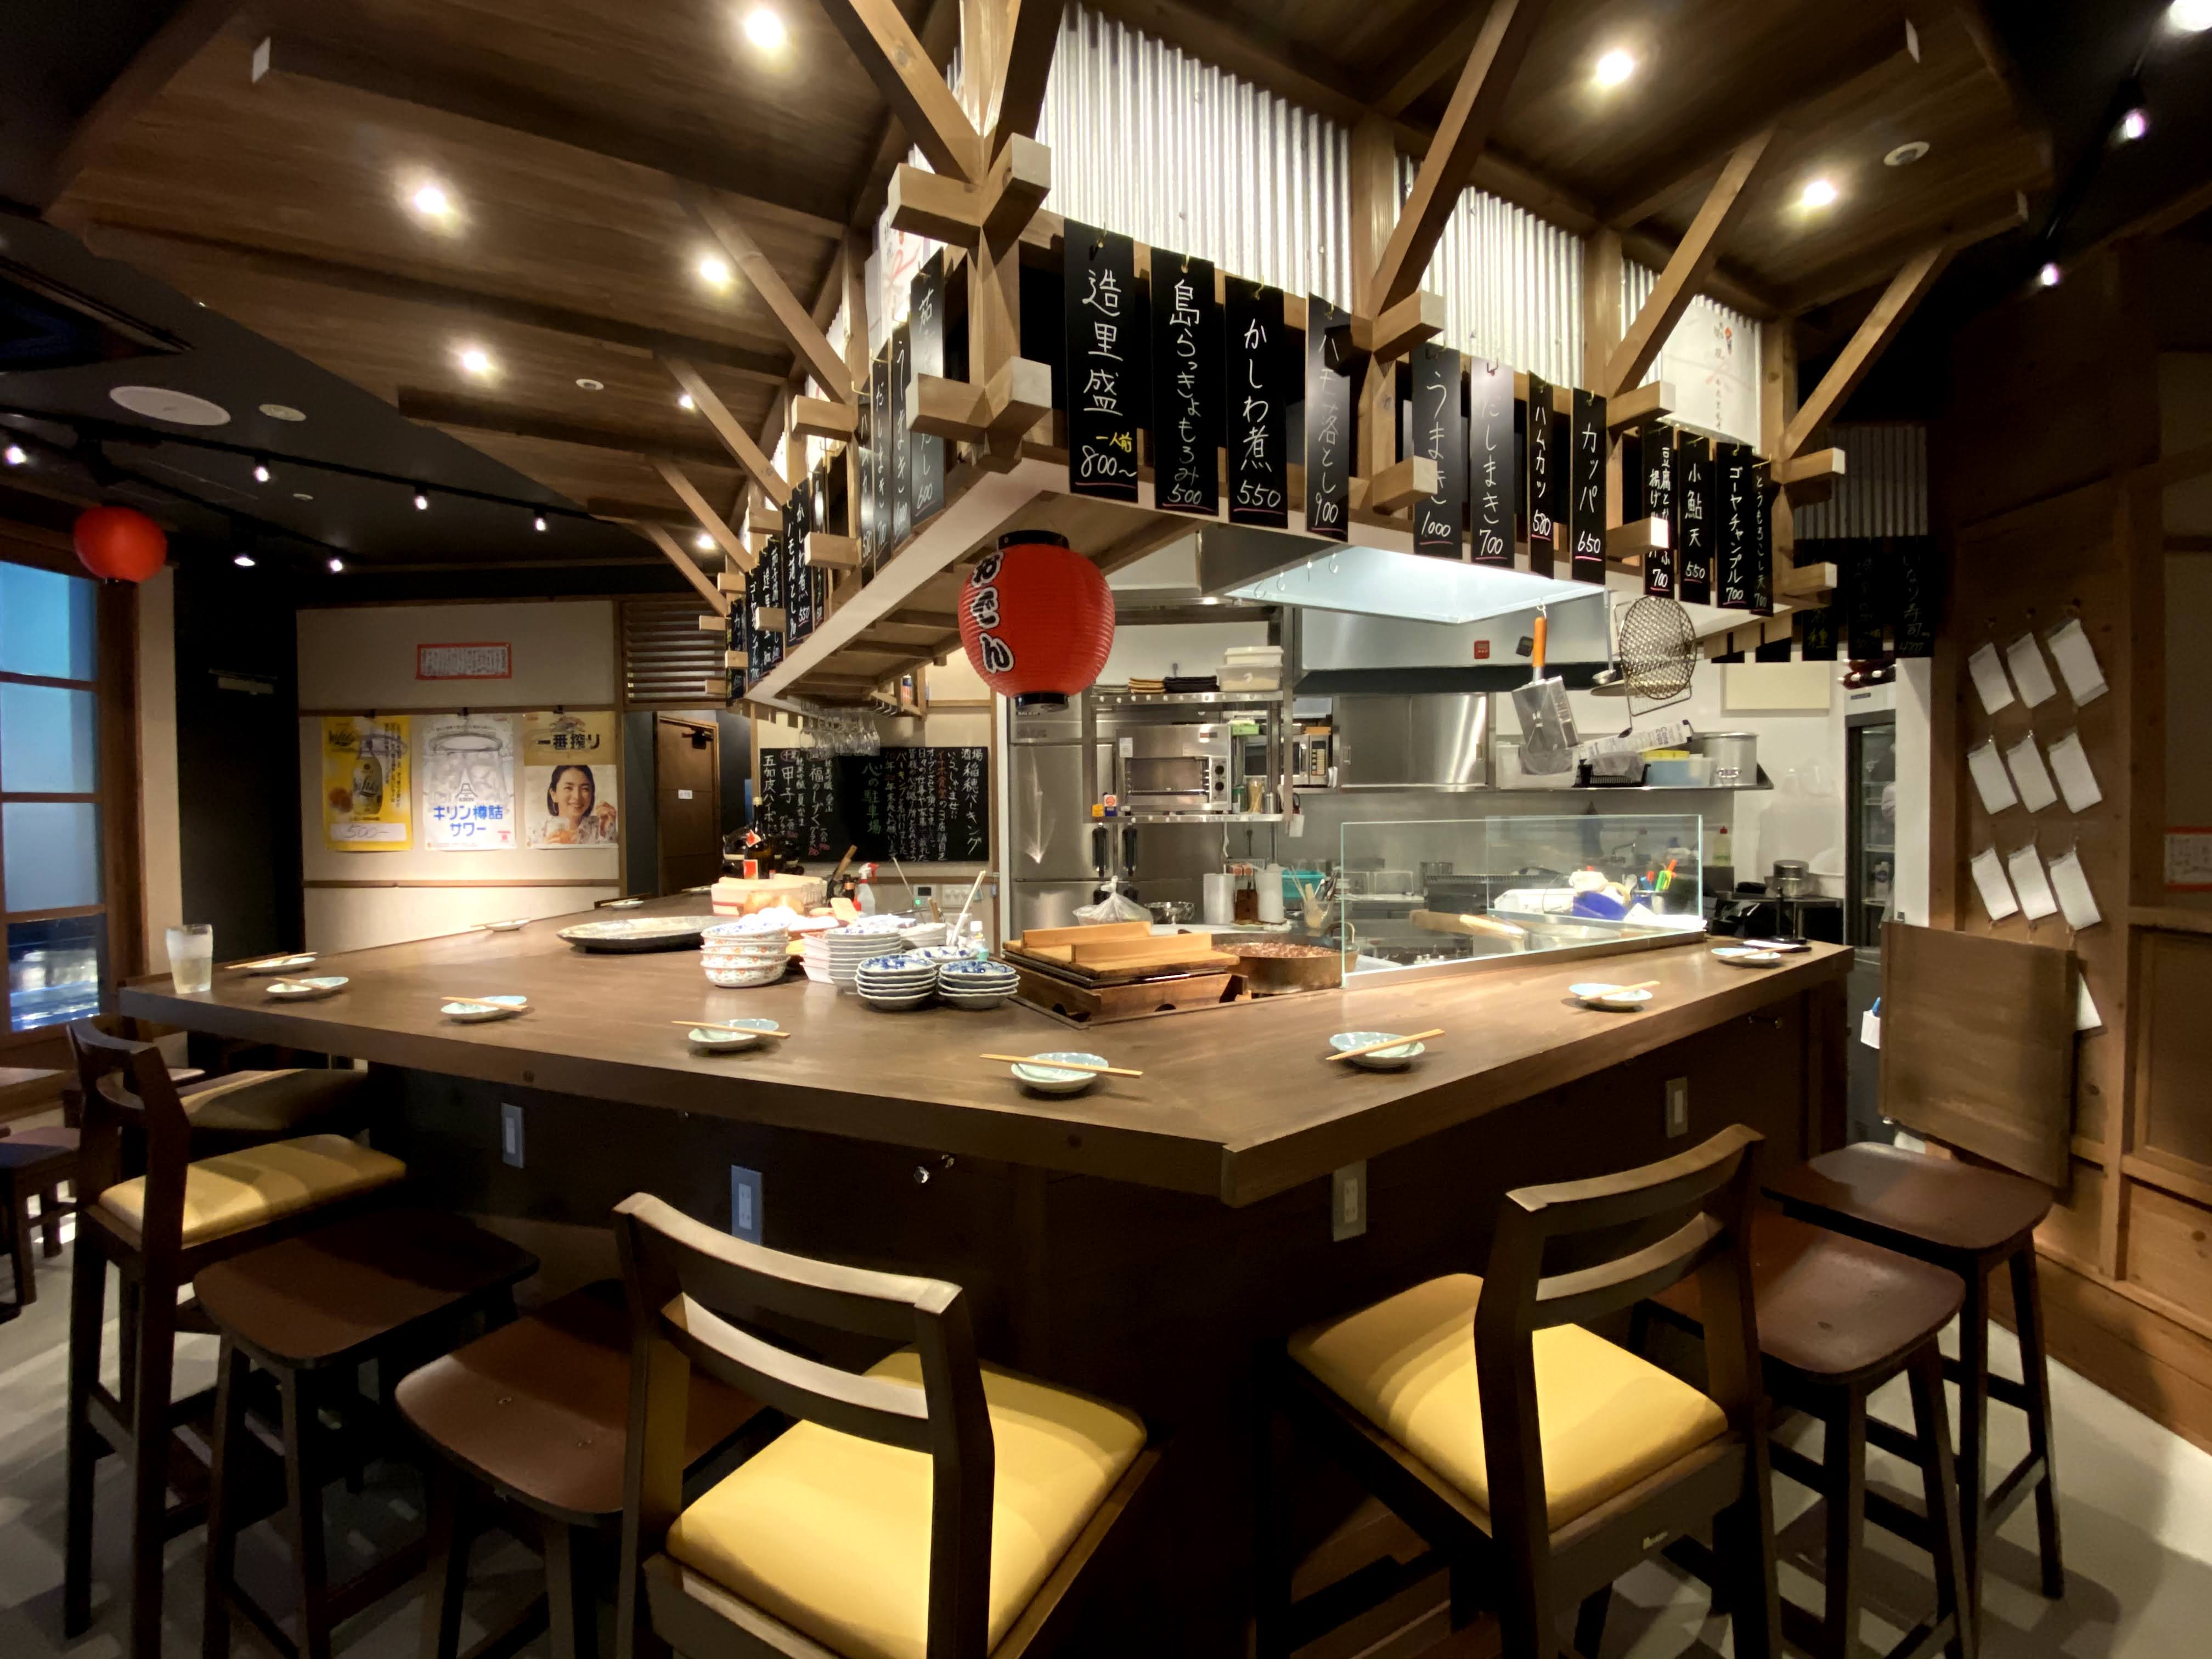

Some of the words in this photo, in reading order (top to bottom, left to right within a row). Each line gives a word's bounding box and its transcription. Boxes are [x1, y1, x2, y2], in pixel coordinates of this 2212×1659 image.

[1082, 269, 1124, 416] 造里盛
[1240, 318, 1272, 473] かしわ煮
[1096, 432, 1133, 452] 一人前
[1426, 370, 1447, 505] うまき
[1481, 395, 1502, 525] だしまき
[1535, 406, 1547, 499] ハムカツ
[1579, 422, 1599, 514] カッパ
[1167, 483, 1203, 505] 500
[1237, 481, 1282, 508] 550
[1685, 463, 1703, 548] 小鮎天
[1314, 492, 1339, 525] 900
[1420, 511, 1451, 538] 1000
[1726, 466, 1745, 584] ゴーヤチャンプル
[1480, 529, 1504, 555] 700
[1577, 531, 1601, 554] 650
[1652, 568, 1668, 588] 700
[1685, 561, 1706, 579] 550
[1726, 587, 1744, 602] 700
[798, 606, 810, 622] 550
[537, 733, 600, 750] 一番搾り
[779, 766, 795, 804] 甲子
[433, 805, 504, 821] キリン樽詰
[450, 822, 487, 837] サワー
